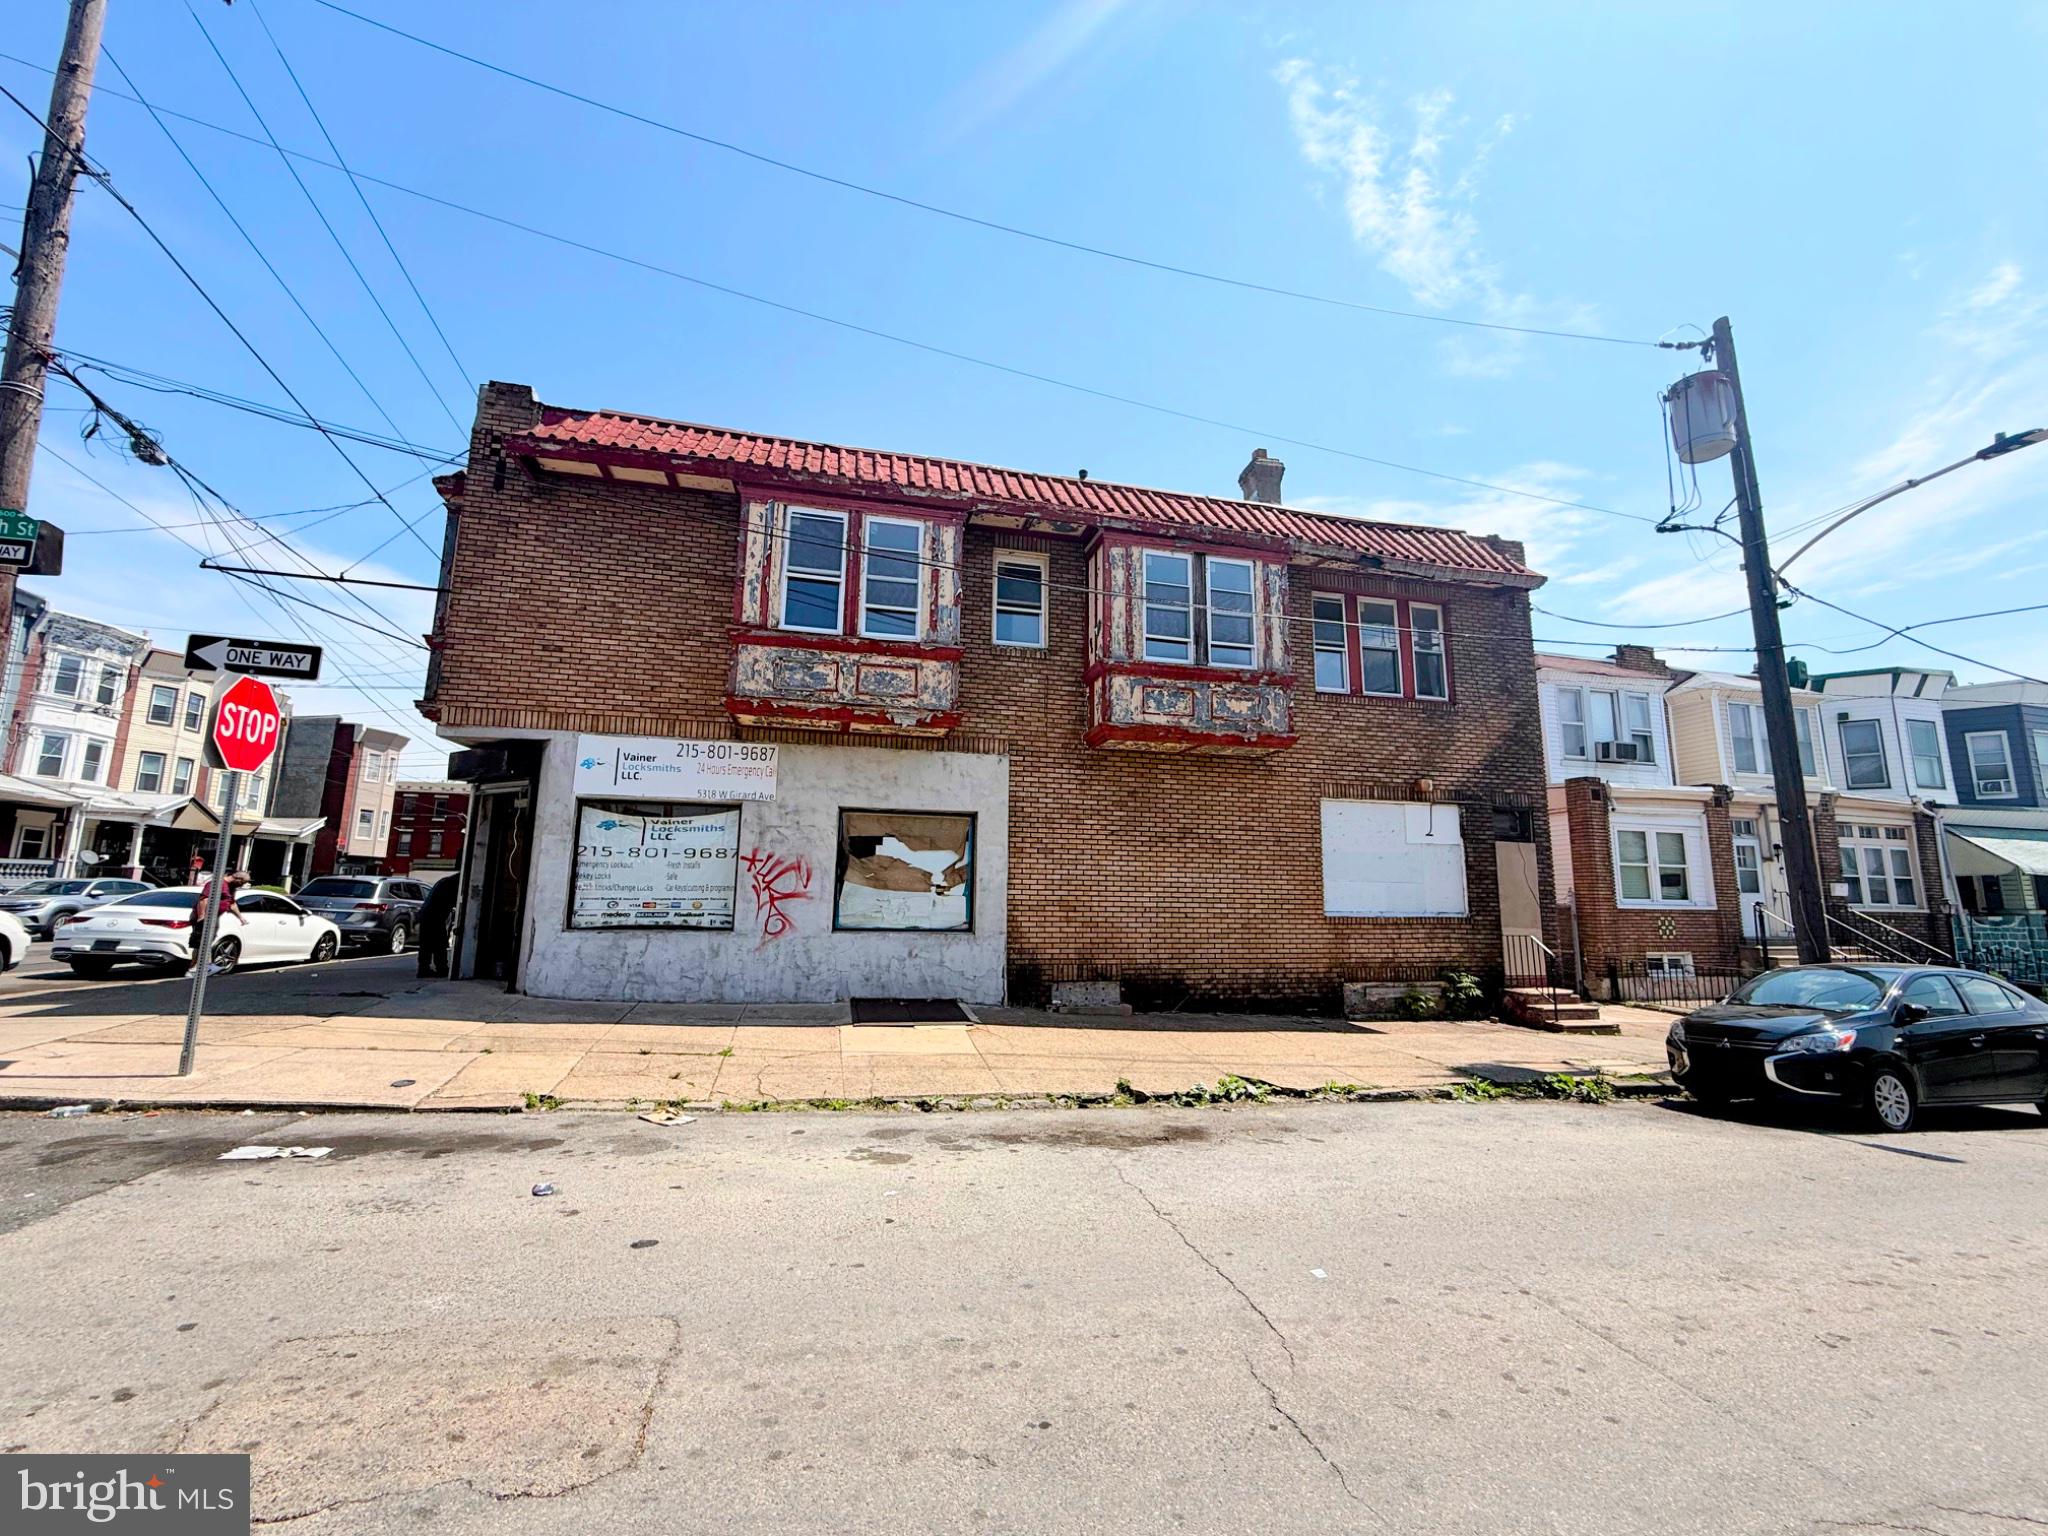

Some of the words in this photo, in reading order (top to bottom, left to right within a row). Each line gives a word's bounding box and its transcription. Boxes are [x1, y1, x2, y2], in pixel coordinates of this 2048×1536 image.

[16, 521, 34, 536] St
[226, 648, 263, 664] ONE
[269, 652, 306, 668] WAY
[220, 702, 276, 745] STOP
[623, 752, 657, 762] Vainer
[676, 743, 776, 761] 215-801-9687
[622, 762, 682, 773] Locksmiths
[697, 762, 705, 774] 24
[707, 764, 726, 775] Hours
[727, 764, 763, 779] Emergency
[621, 771, 642, 780] LLC.
[697, 789, 717, 799] 5318
[718, 790, 728, 799] W
[729, 790, 757, 800] Girard
[758, 791, 775, 800] Ave
[651, 824, 726, 833] Locksmiths
[650, 833, 676, 841] LLC.
[577, 846, 738, 859] 215-801-9687
